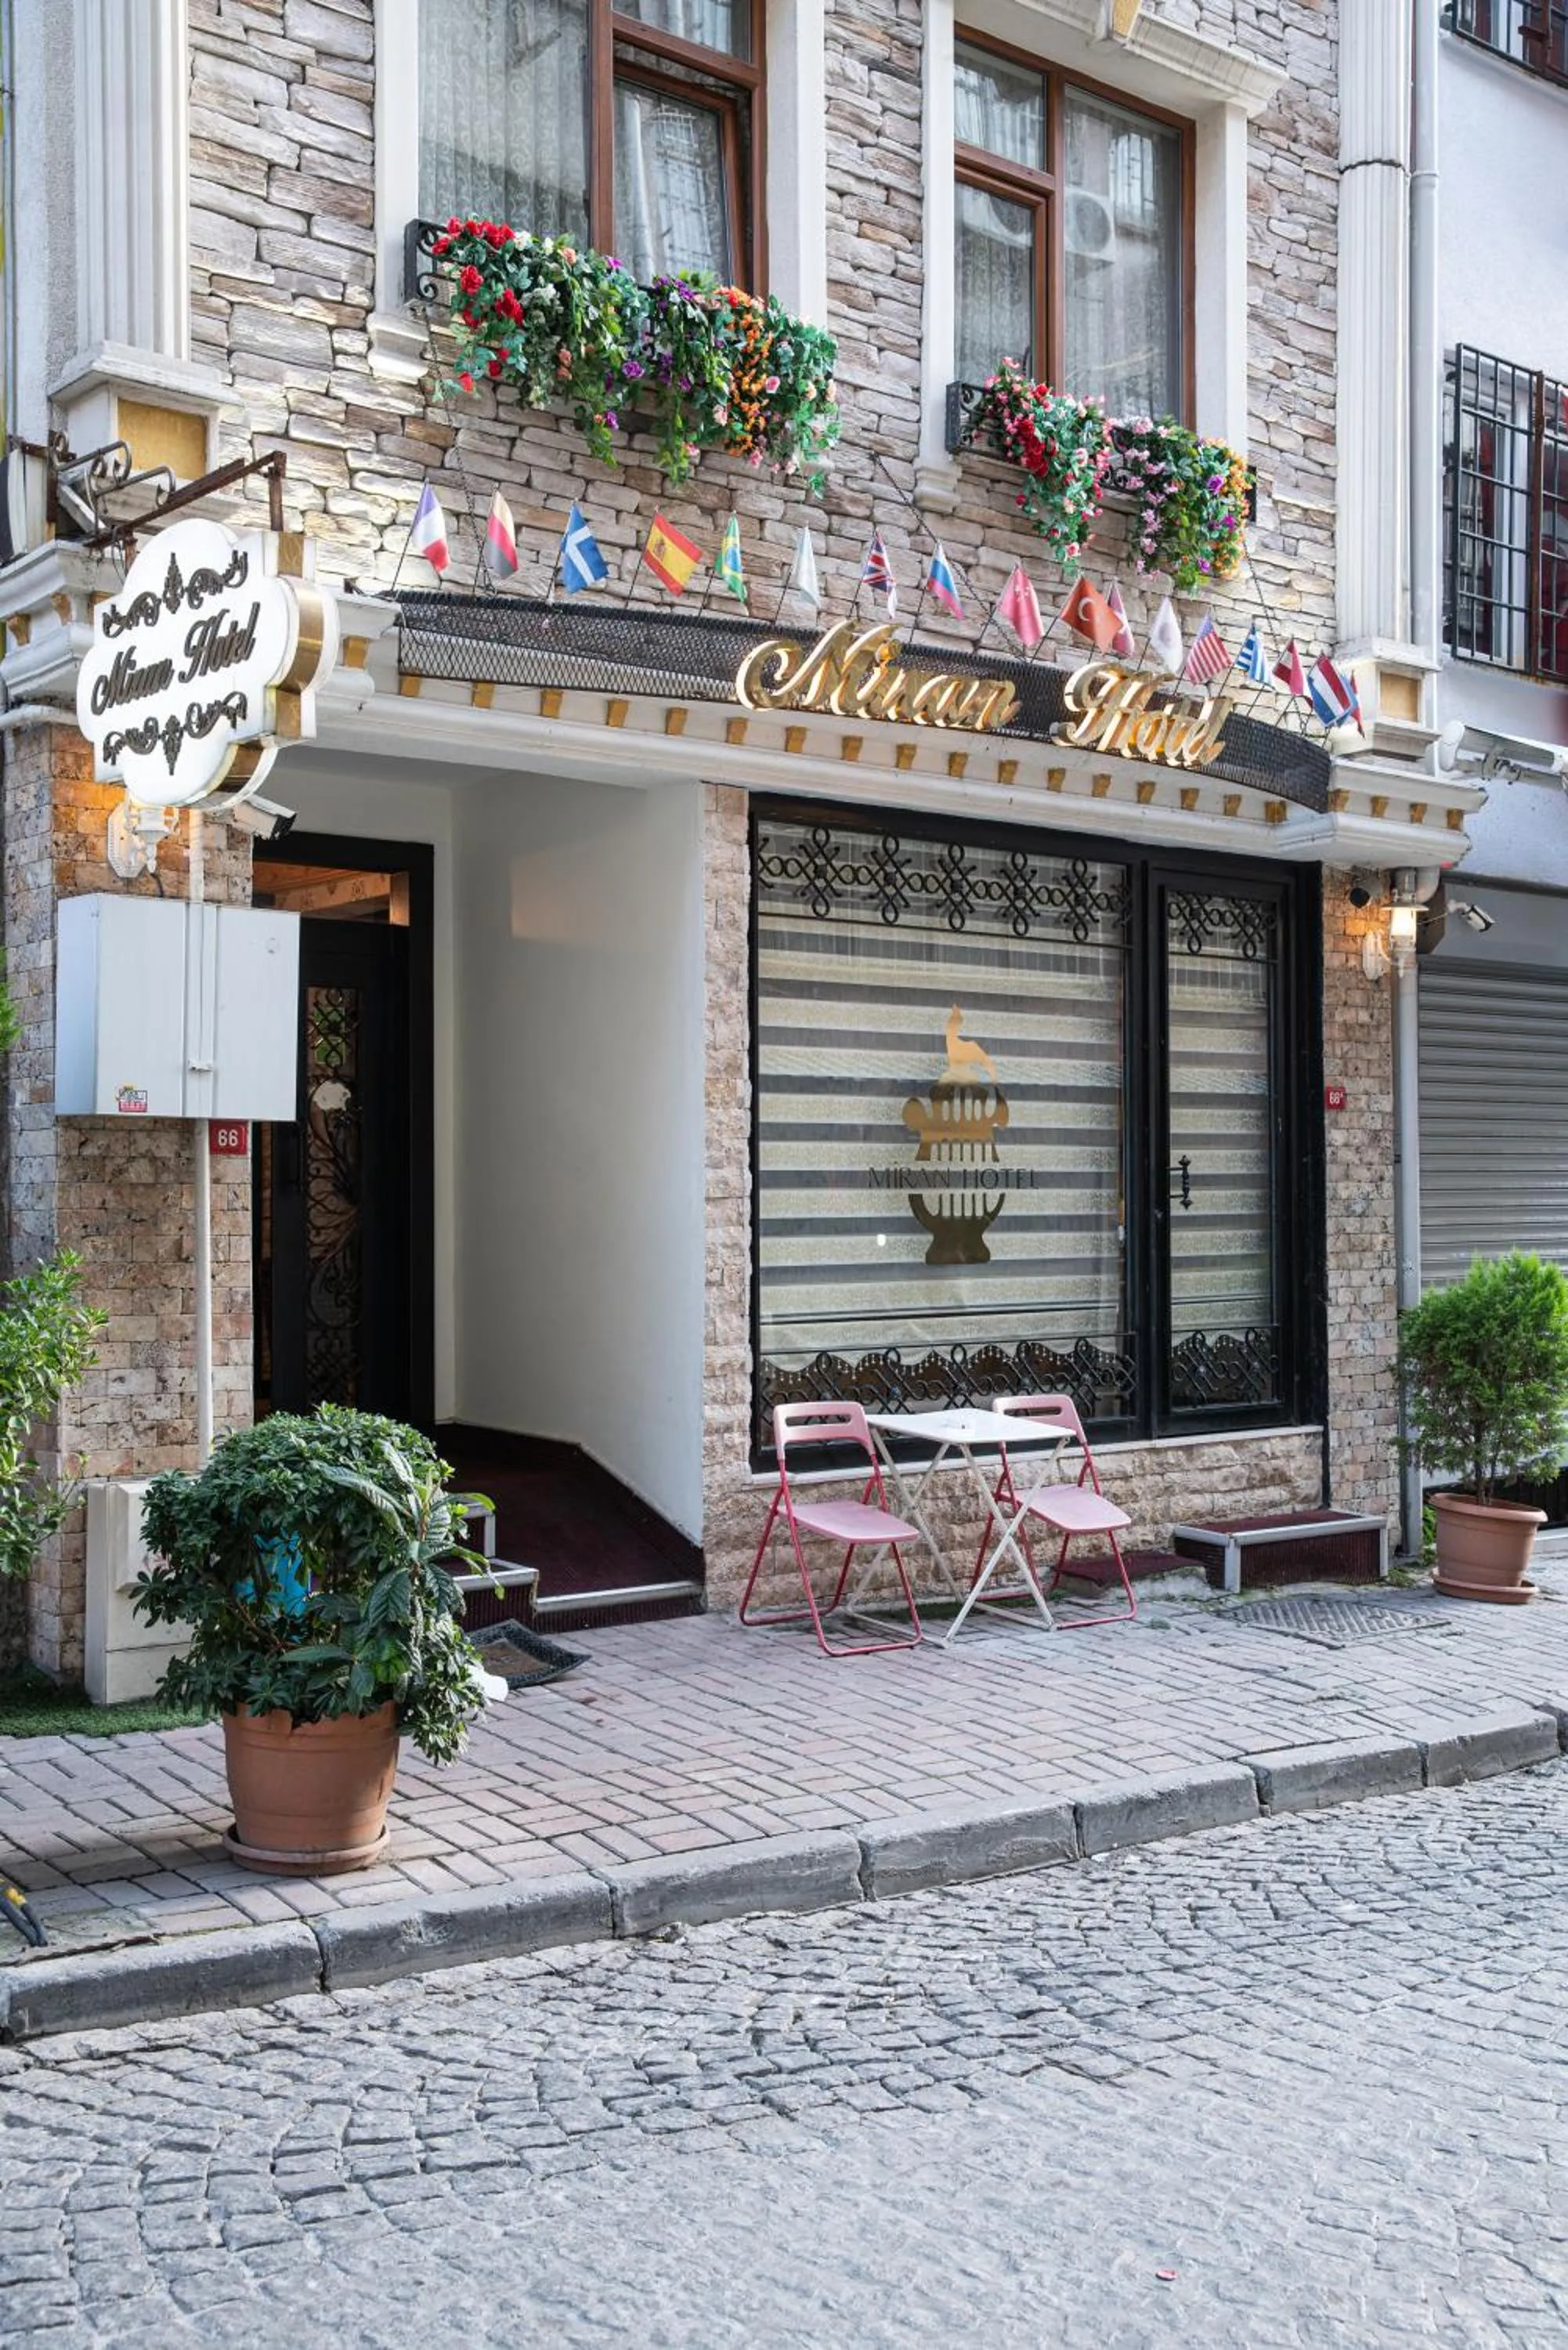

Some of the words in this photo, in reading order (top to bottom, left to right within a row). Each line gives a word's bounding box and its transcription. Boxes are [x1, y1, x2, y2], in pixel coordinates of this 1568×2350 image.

[178, 601, 261, 683] Hotel
[735, 619, 1021, 732] Miran
[1050, 662, 1234, 768] Hotel
[218, 1129, 239, 1146] 66
[963, 1167, 1040, 1190] HOTEL
